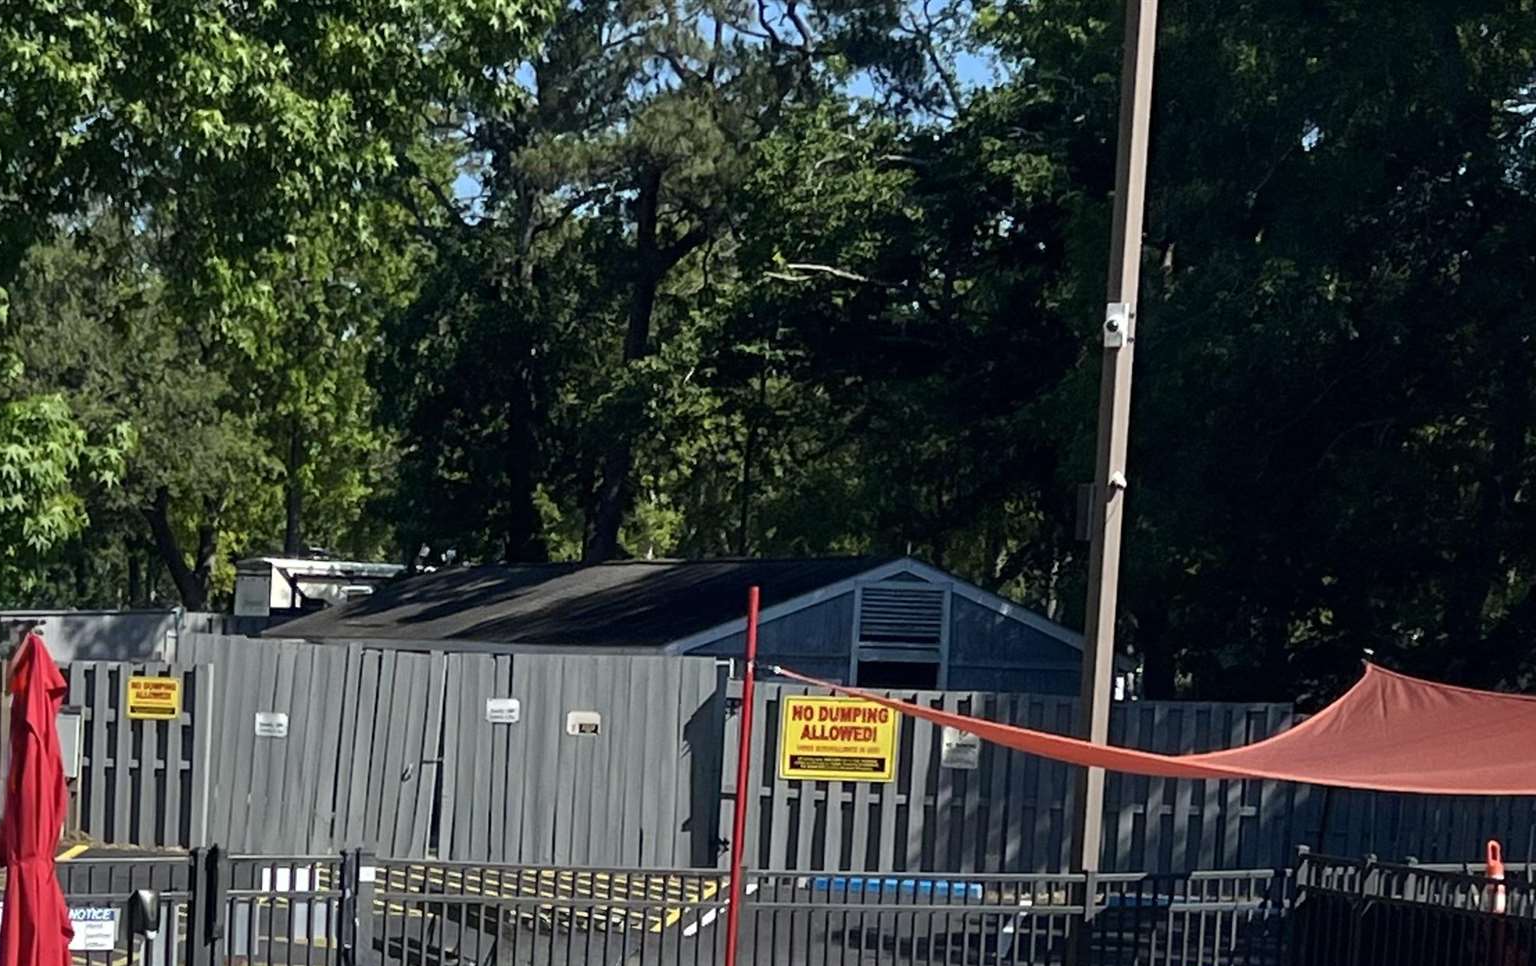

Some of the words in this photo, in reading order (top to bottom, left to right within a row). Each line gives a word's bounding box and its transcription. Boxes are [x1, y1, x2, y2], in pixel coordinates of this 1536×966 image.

[792, 705, 814, 721] NO
[818, 706, 889, 724] DUMPING
[801, 724, 877, 742] ALLOWED!
[68, 908, 112, 920] NOTICE
